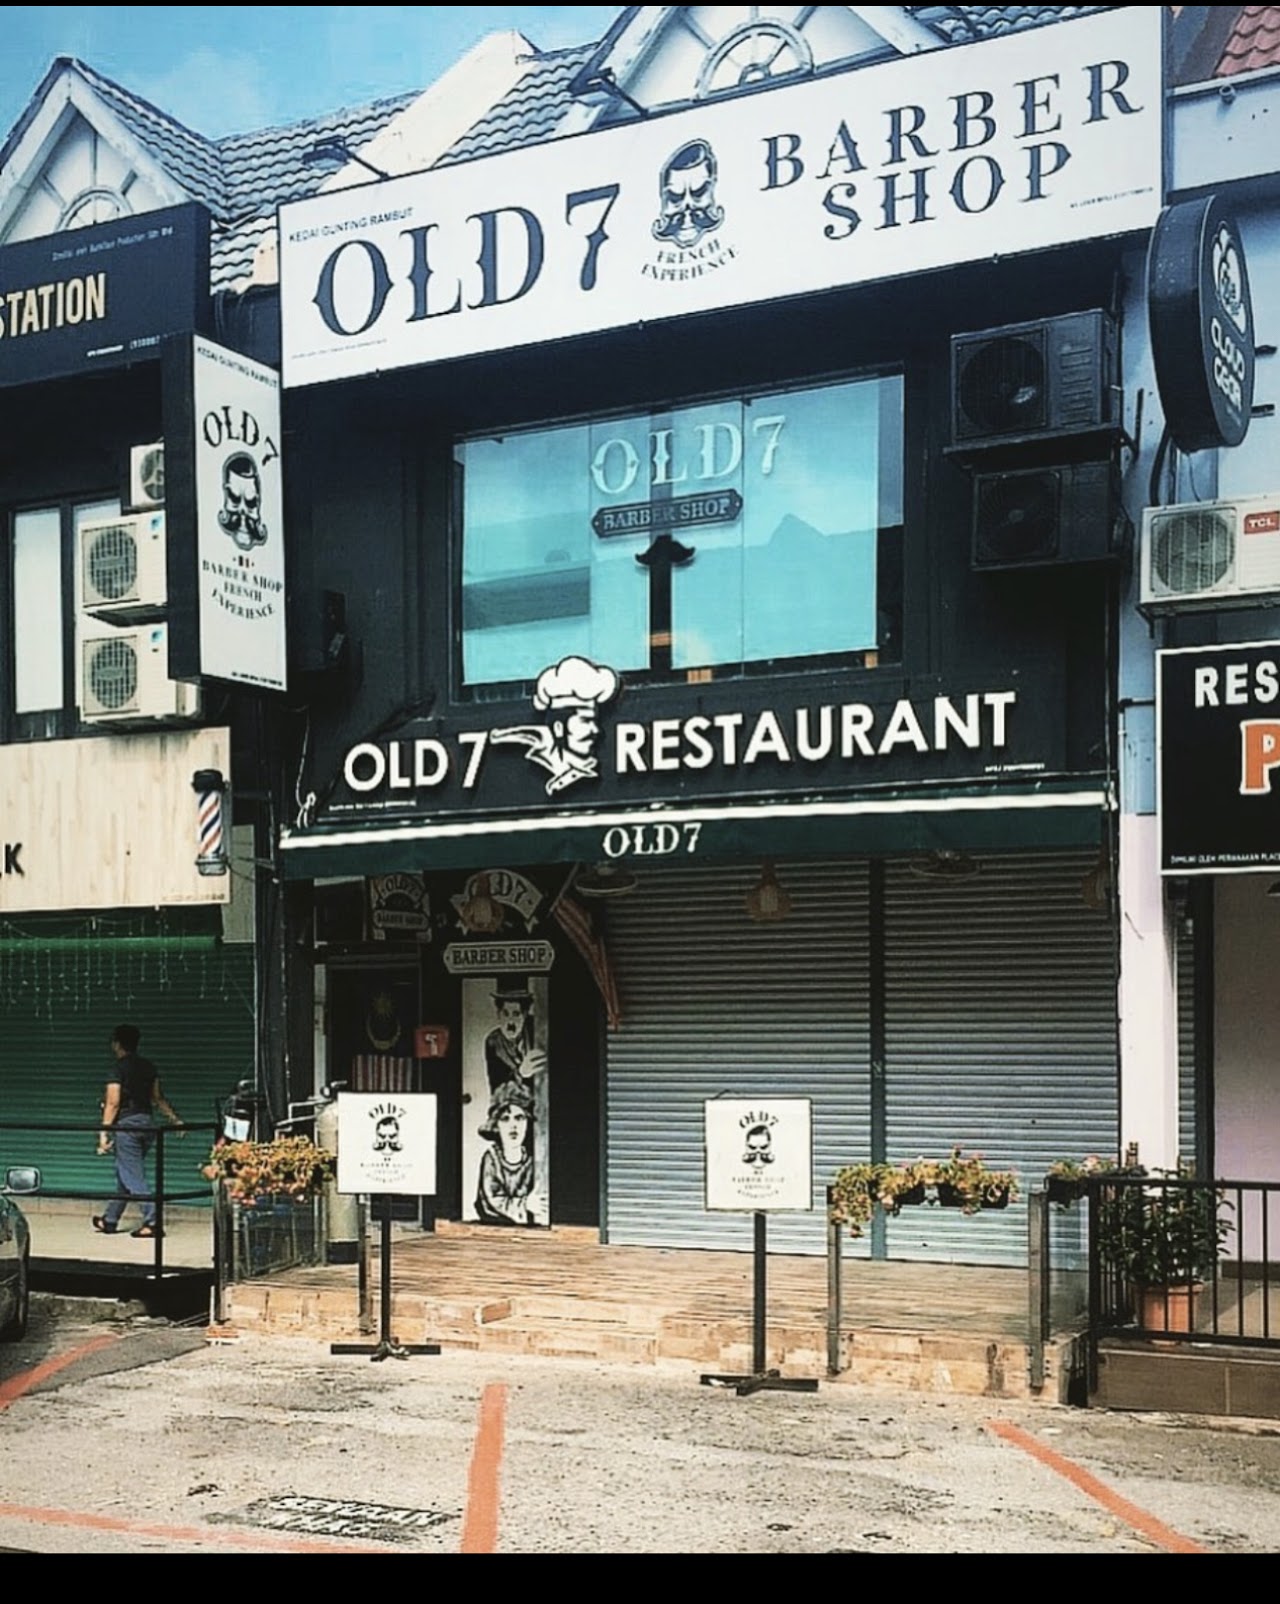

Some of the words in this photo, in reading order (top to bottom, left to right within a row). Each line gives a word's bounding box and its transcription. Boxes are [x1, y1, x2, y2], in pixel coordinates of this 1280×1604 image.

[760, 59, 1144, 191] BARBER
[821, 141, 1072, 240] SHOP
[312, 206, 545, 337] OLD
[565, 182, 620, 291] 7
[641, 243, 739, 282] EXPERIENCE
[656, 239, 721, 264] FRENCH
[203, 405, 260, 448] OLD
[602, 508, 677, 531] BARBER
[679, 497, 731, 520] SHOP
[1248, 517, 1276, 528] TCL
[1194, 660, 1280, 708] RES
[344, 739, 449, 792] OLD
[458, 731, 489, 789] 7
[615, 691, 1016, 773] RESTAURANT
[1239, 718, 1280, 795] P
[452, 949, 506, 966] BARBER
[508, 947, 547, 964] SHOP
